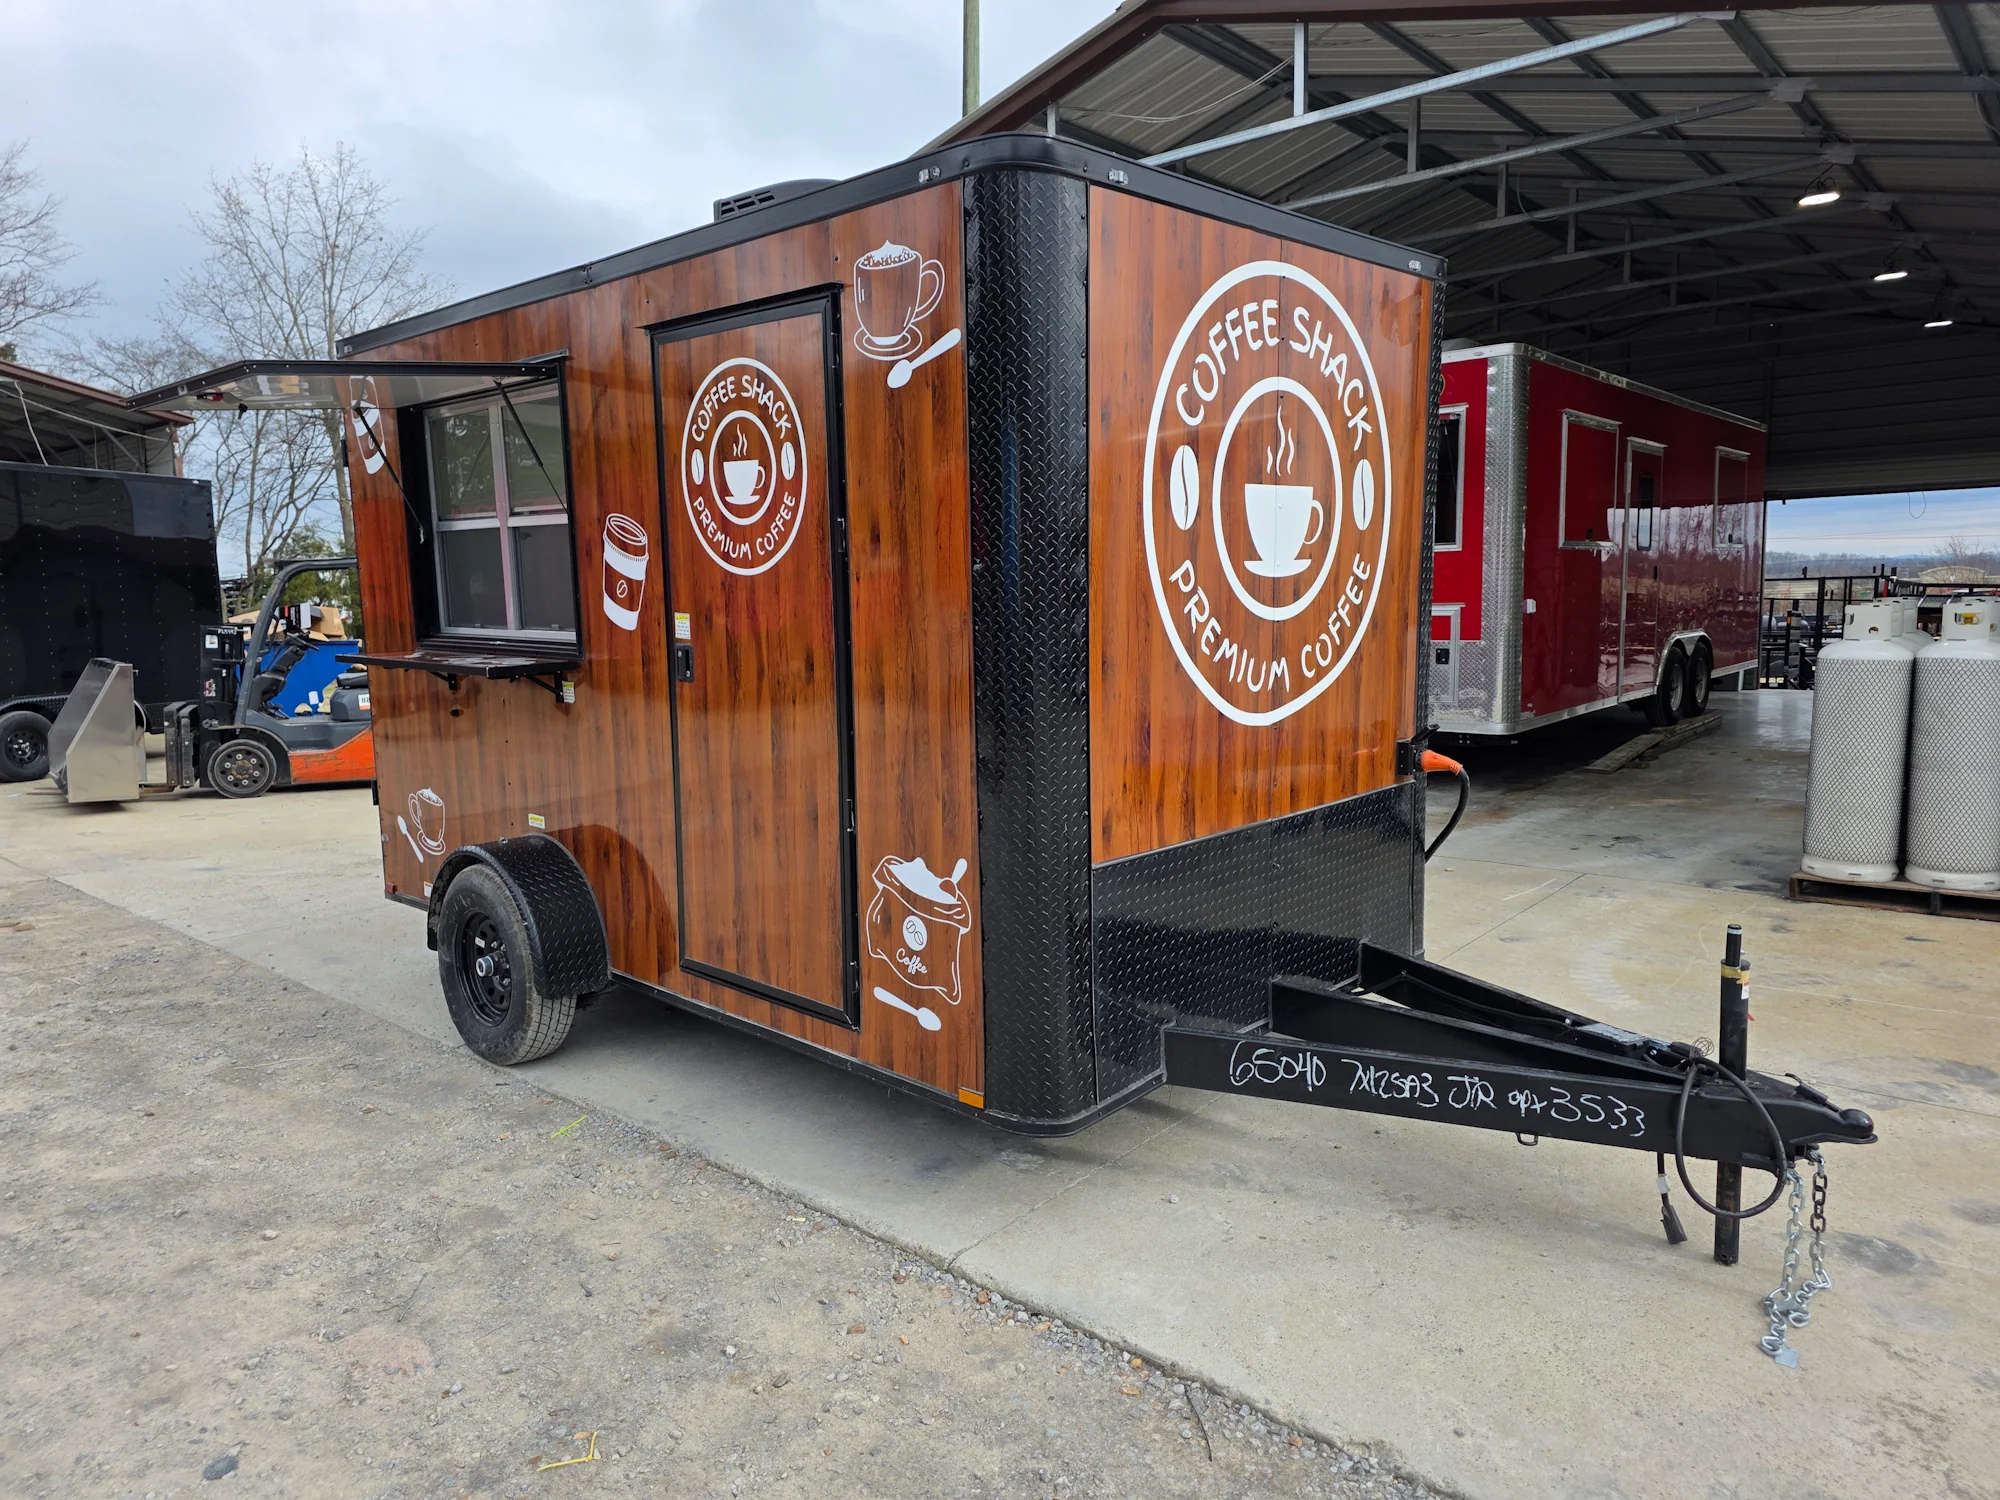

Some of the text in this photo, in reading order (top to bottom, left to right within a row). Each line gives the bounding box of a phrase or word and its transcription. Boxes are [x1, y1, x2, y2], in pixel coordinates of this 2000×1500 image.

[691, 374, 792, 442] COFFEE SHACK
[1176, 299, 1373, 451] COFFEE SHACK
[693, 492, 796, 560] PREMIUM COFFEE
[1169, 552, 1371, 693] PREMIUM COFFEE
[896, 948, 928, 975] Coffee
